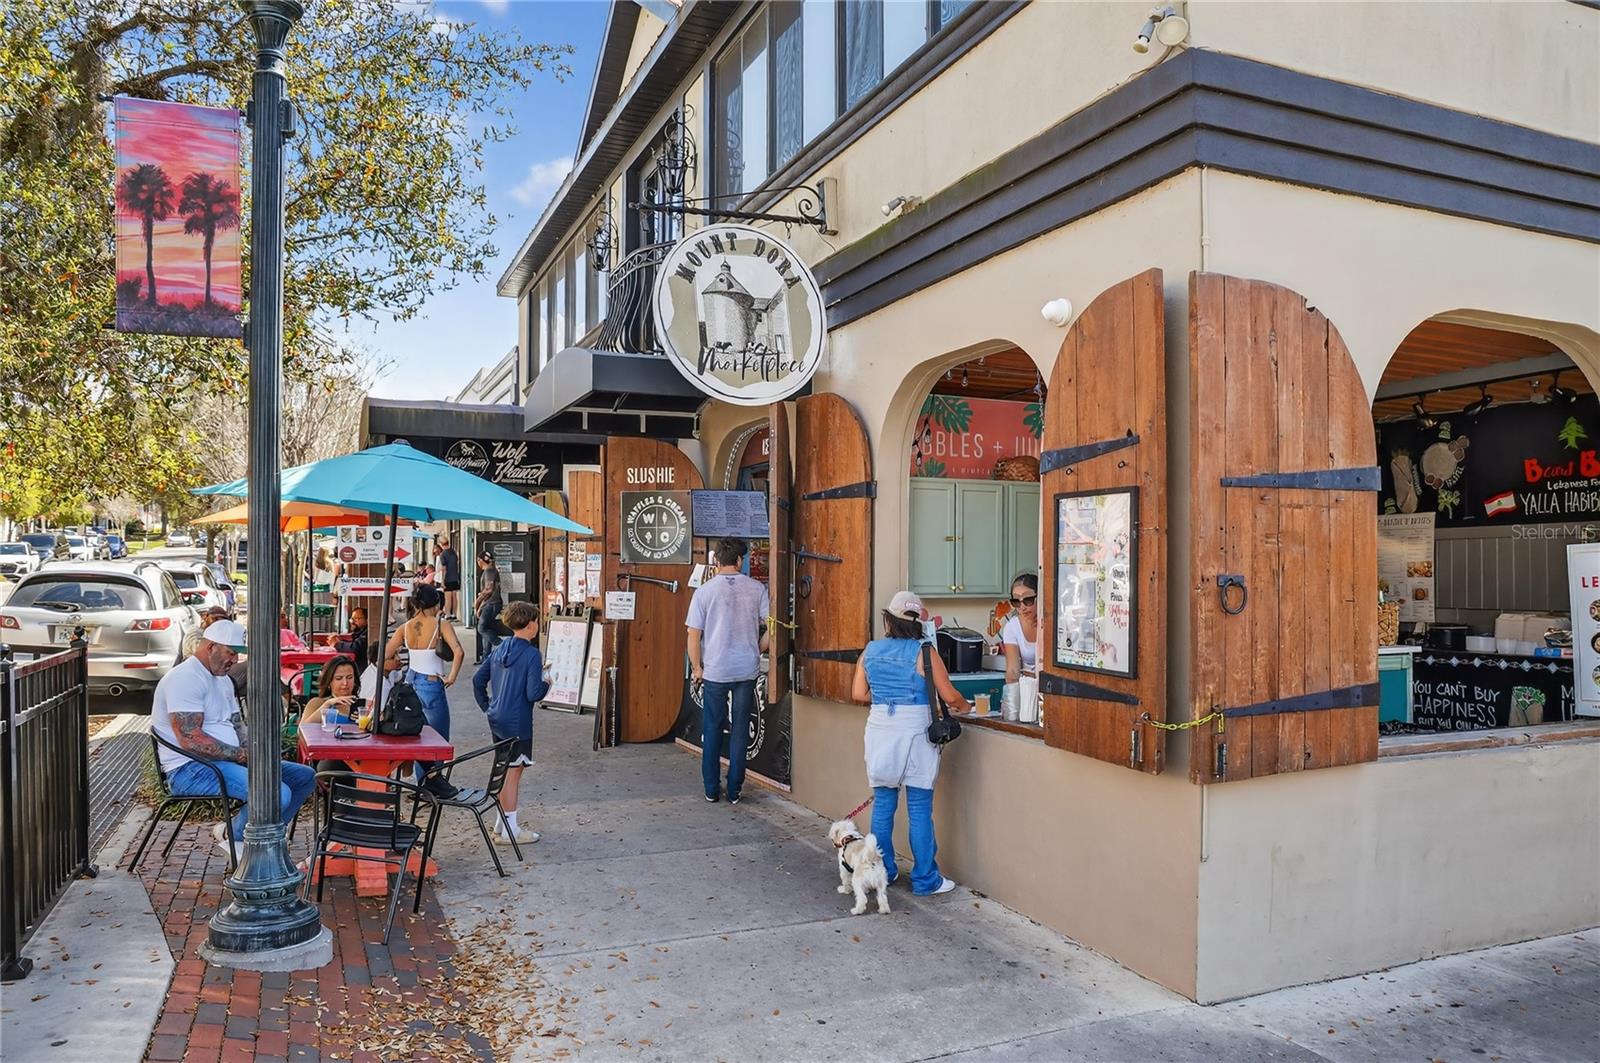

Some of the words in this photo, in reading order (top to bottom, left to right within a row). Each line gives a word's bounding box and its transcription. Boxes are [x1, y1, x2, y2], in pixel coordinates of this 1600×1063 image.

[674, 232, 737, 284] MOUNT
[752, 237, 802, 289] DORA
[697, 330, 806, 382] Marketplace
[491, 441, 529, 463] Wolf
[491, 462, 550, 486] Branch
[626, 466, 675, 484] SLUSHIE
[1547, 479, 1589, 491] Lebanese
[626, 496, 655, 524] WAFFLES
[665, 498, 688, 525] CREAM
[1519, 491, 1561, 516] YALLA
[1412, 680, 1432, 695] YOU
[1473, 686, 1501, 703] BUY
[1413, 694, 1497, 727] HAPPINESS
